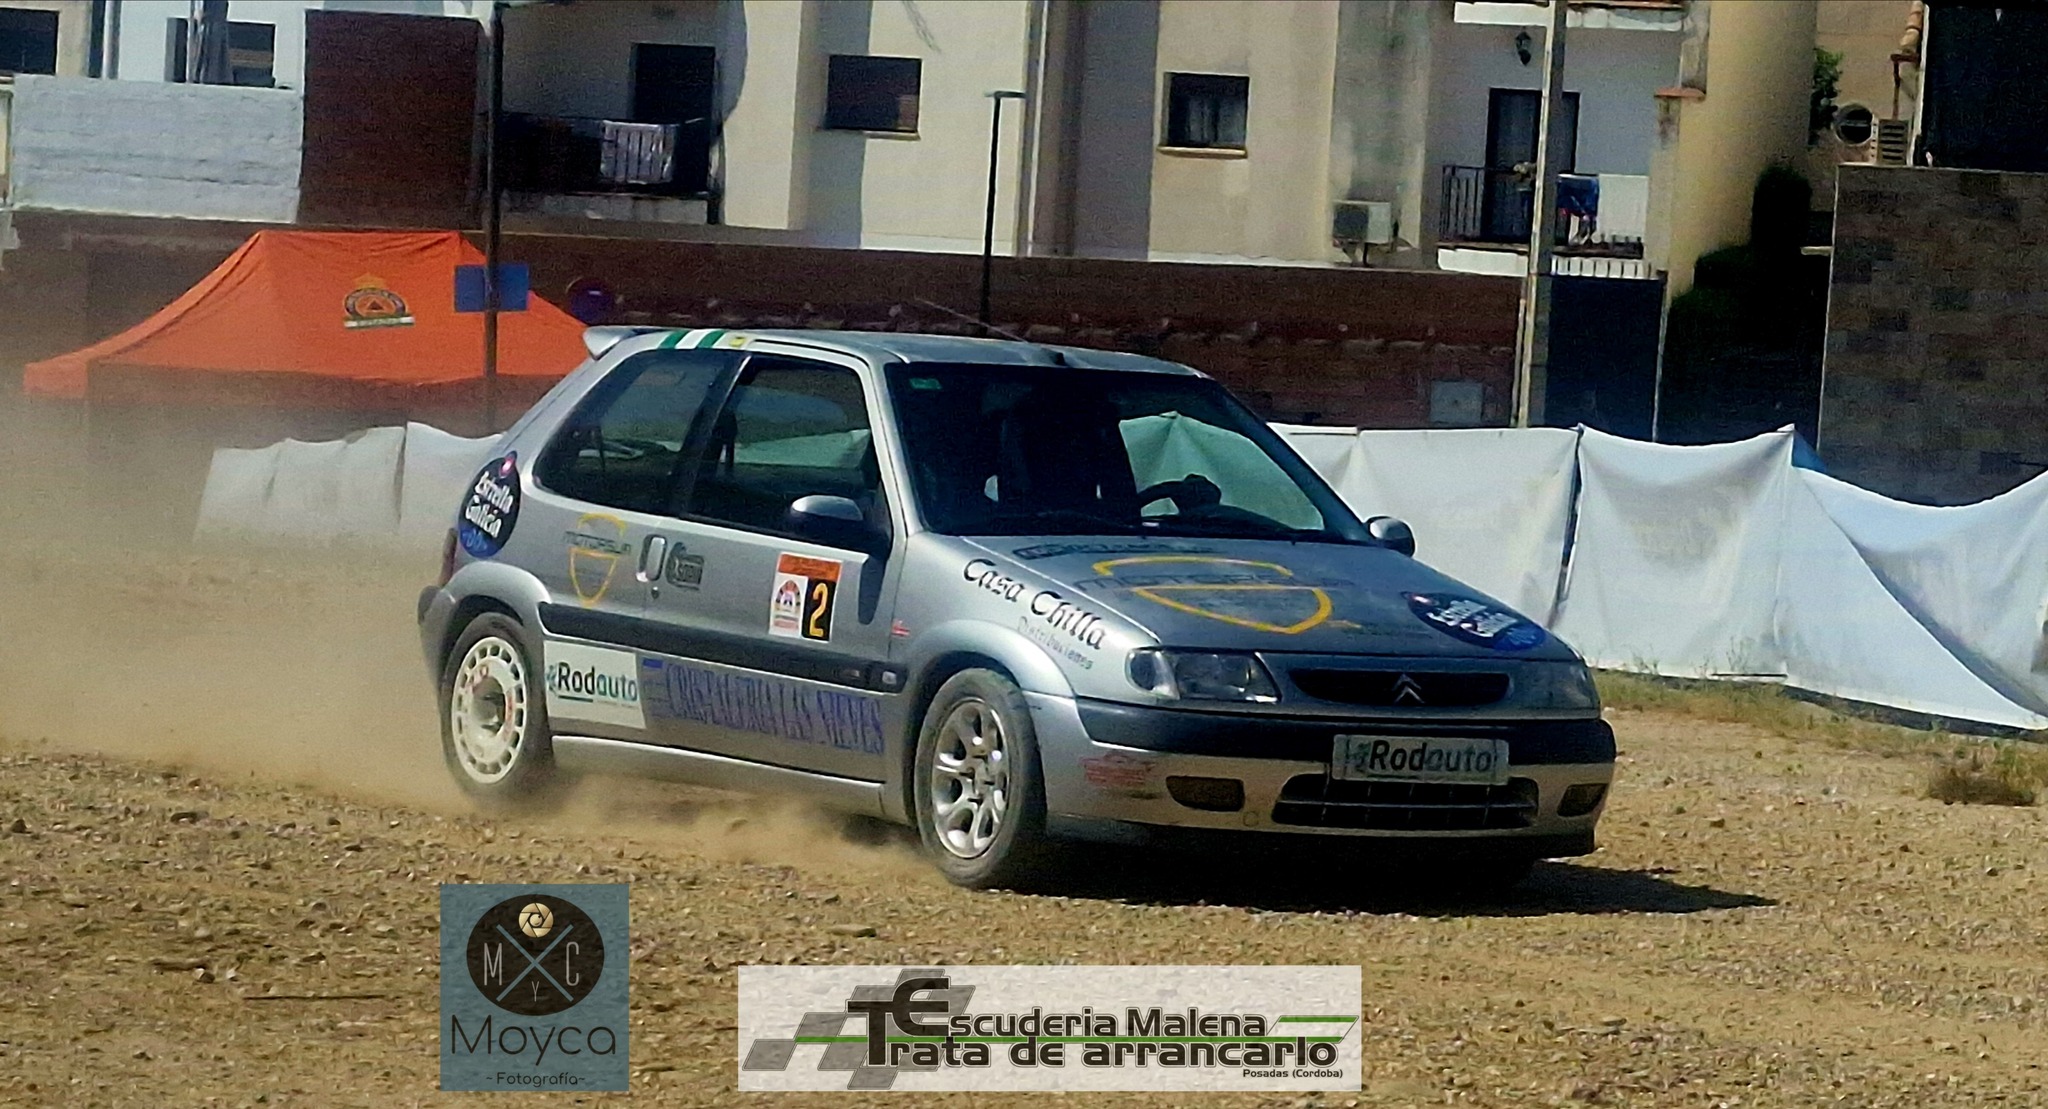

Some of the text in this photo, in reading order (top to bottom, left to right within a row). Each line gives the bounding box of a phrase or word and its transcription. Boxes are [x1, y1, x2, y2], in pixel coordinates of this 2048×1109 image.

[475, 471, 513, 514] Estrella
[809, 582, 828, 637] 2
[963, 558, 1105, 650] Casa Chilla
[558, 661, 638, 702] Rodauto
[1369, 739, 1493, 772] Rodauto
